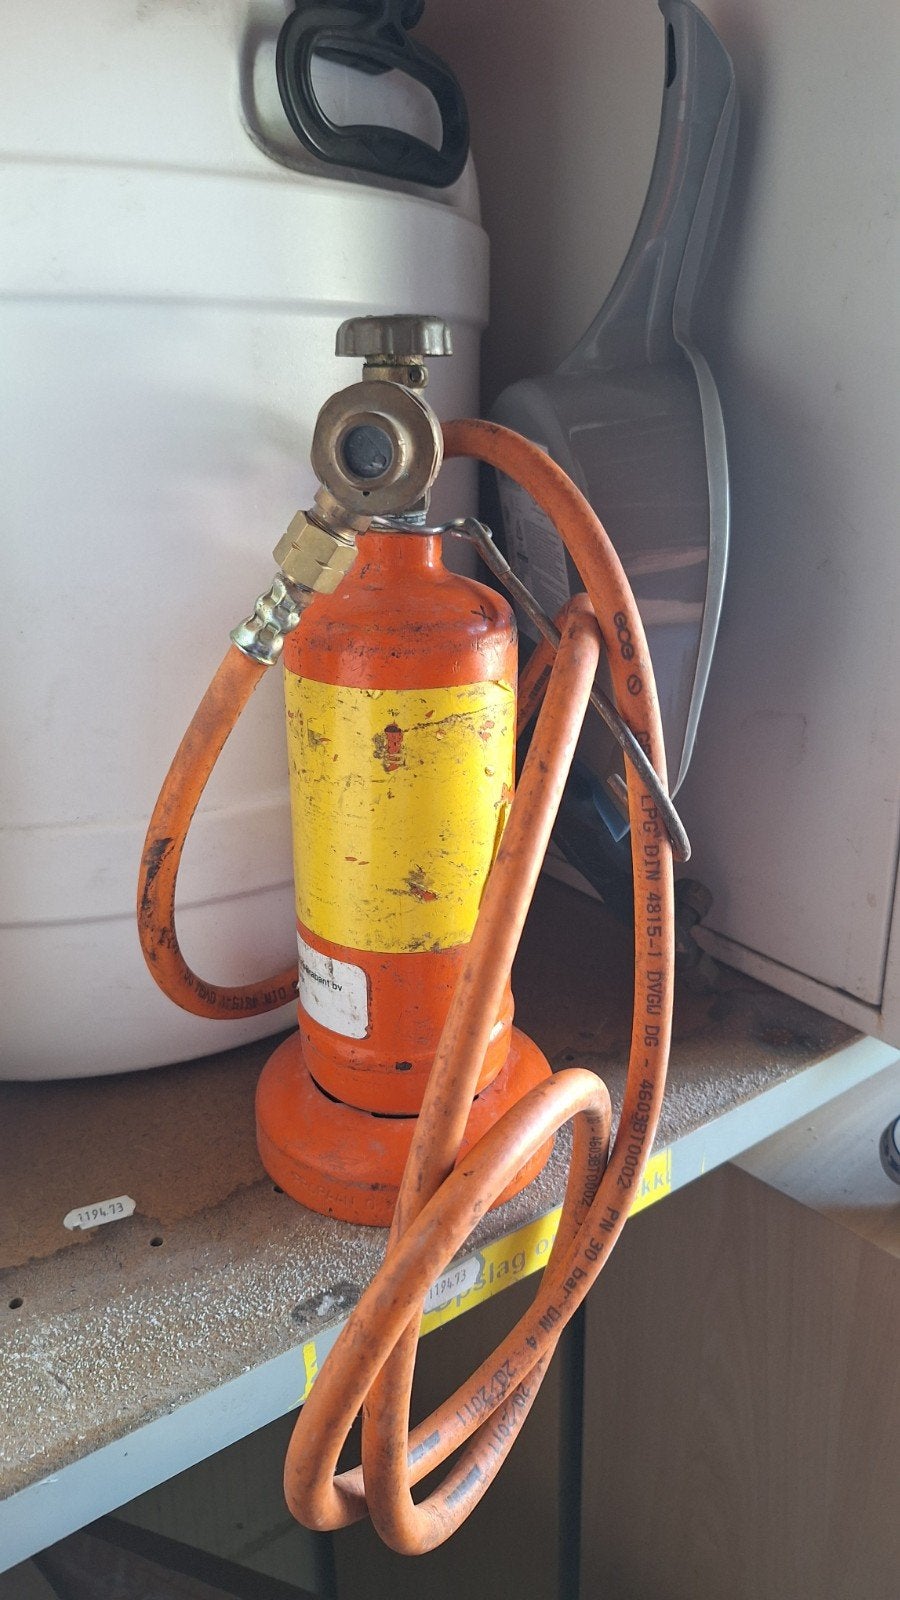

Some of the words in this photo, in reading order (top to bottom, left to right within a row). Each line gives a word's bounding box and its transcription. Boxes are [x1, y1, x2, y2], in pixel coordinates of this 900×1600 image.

[643, 847, 661, 881] DIN
[646, 893, 662, 958] 4815-1
[645, 969, 663, 1016] DVGW
[643, 1025, 660, 1048] DG
[617, 1078, 654, 1189] 4603BT0002
[598, 1207, 620, 1233] PN
[583, 1236, 604, 1262] 30
[563, 1268, 588, 1300] bar
[525, 1335, 538, 1350] 4
